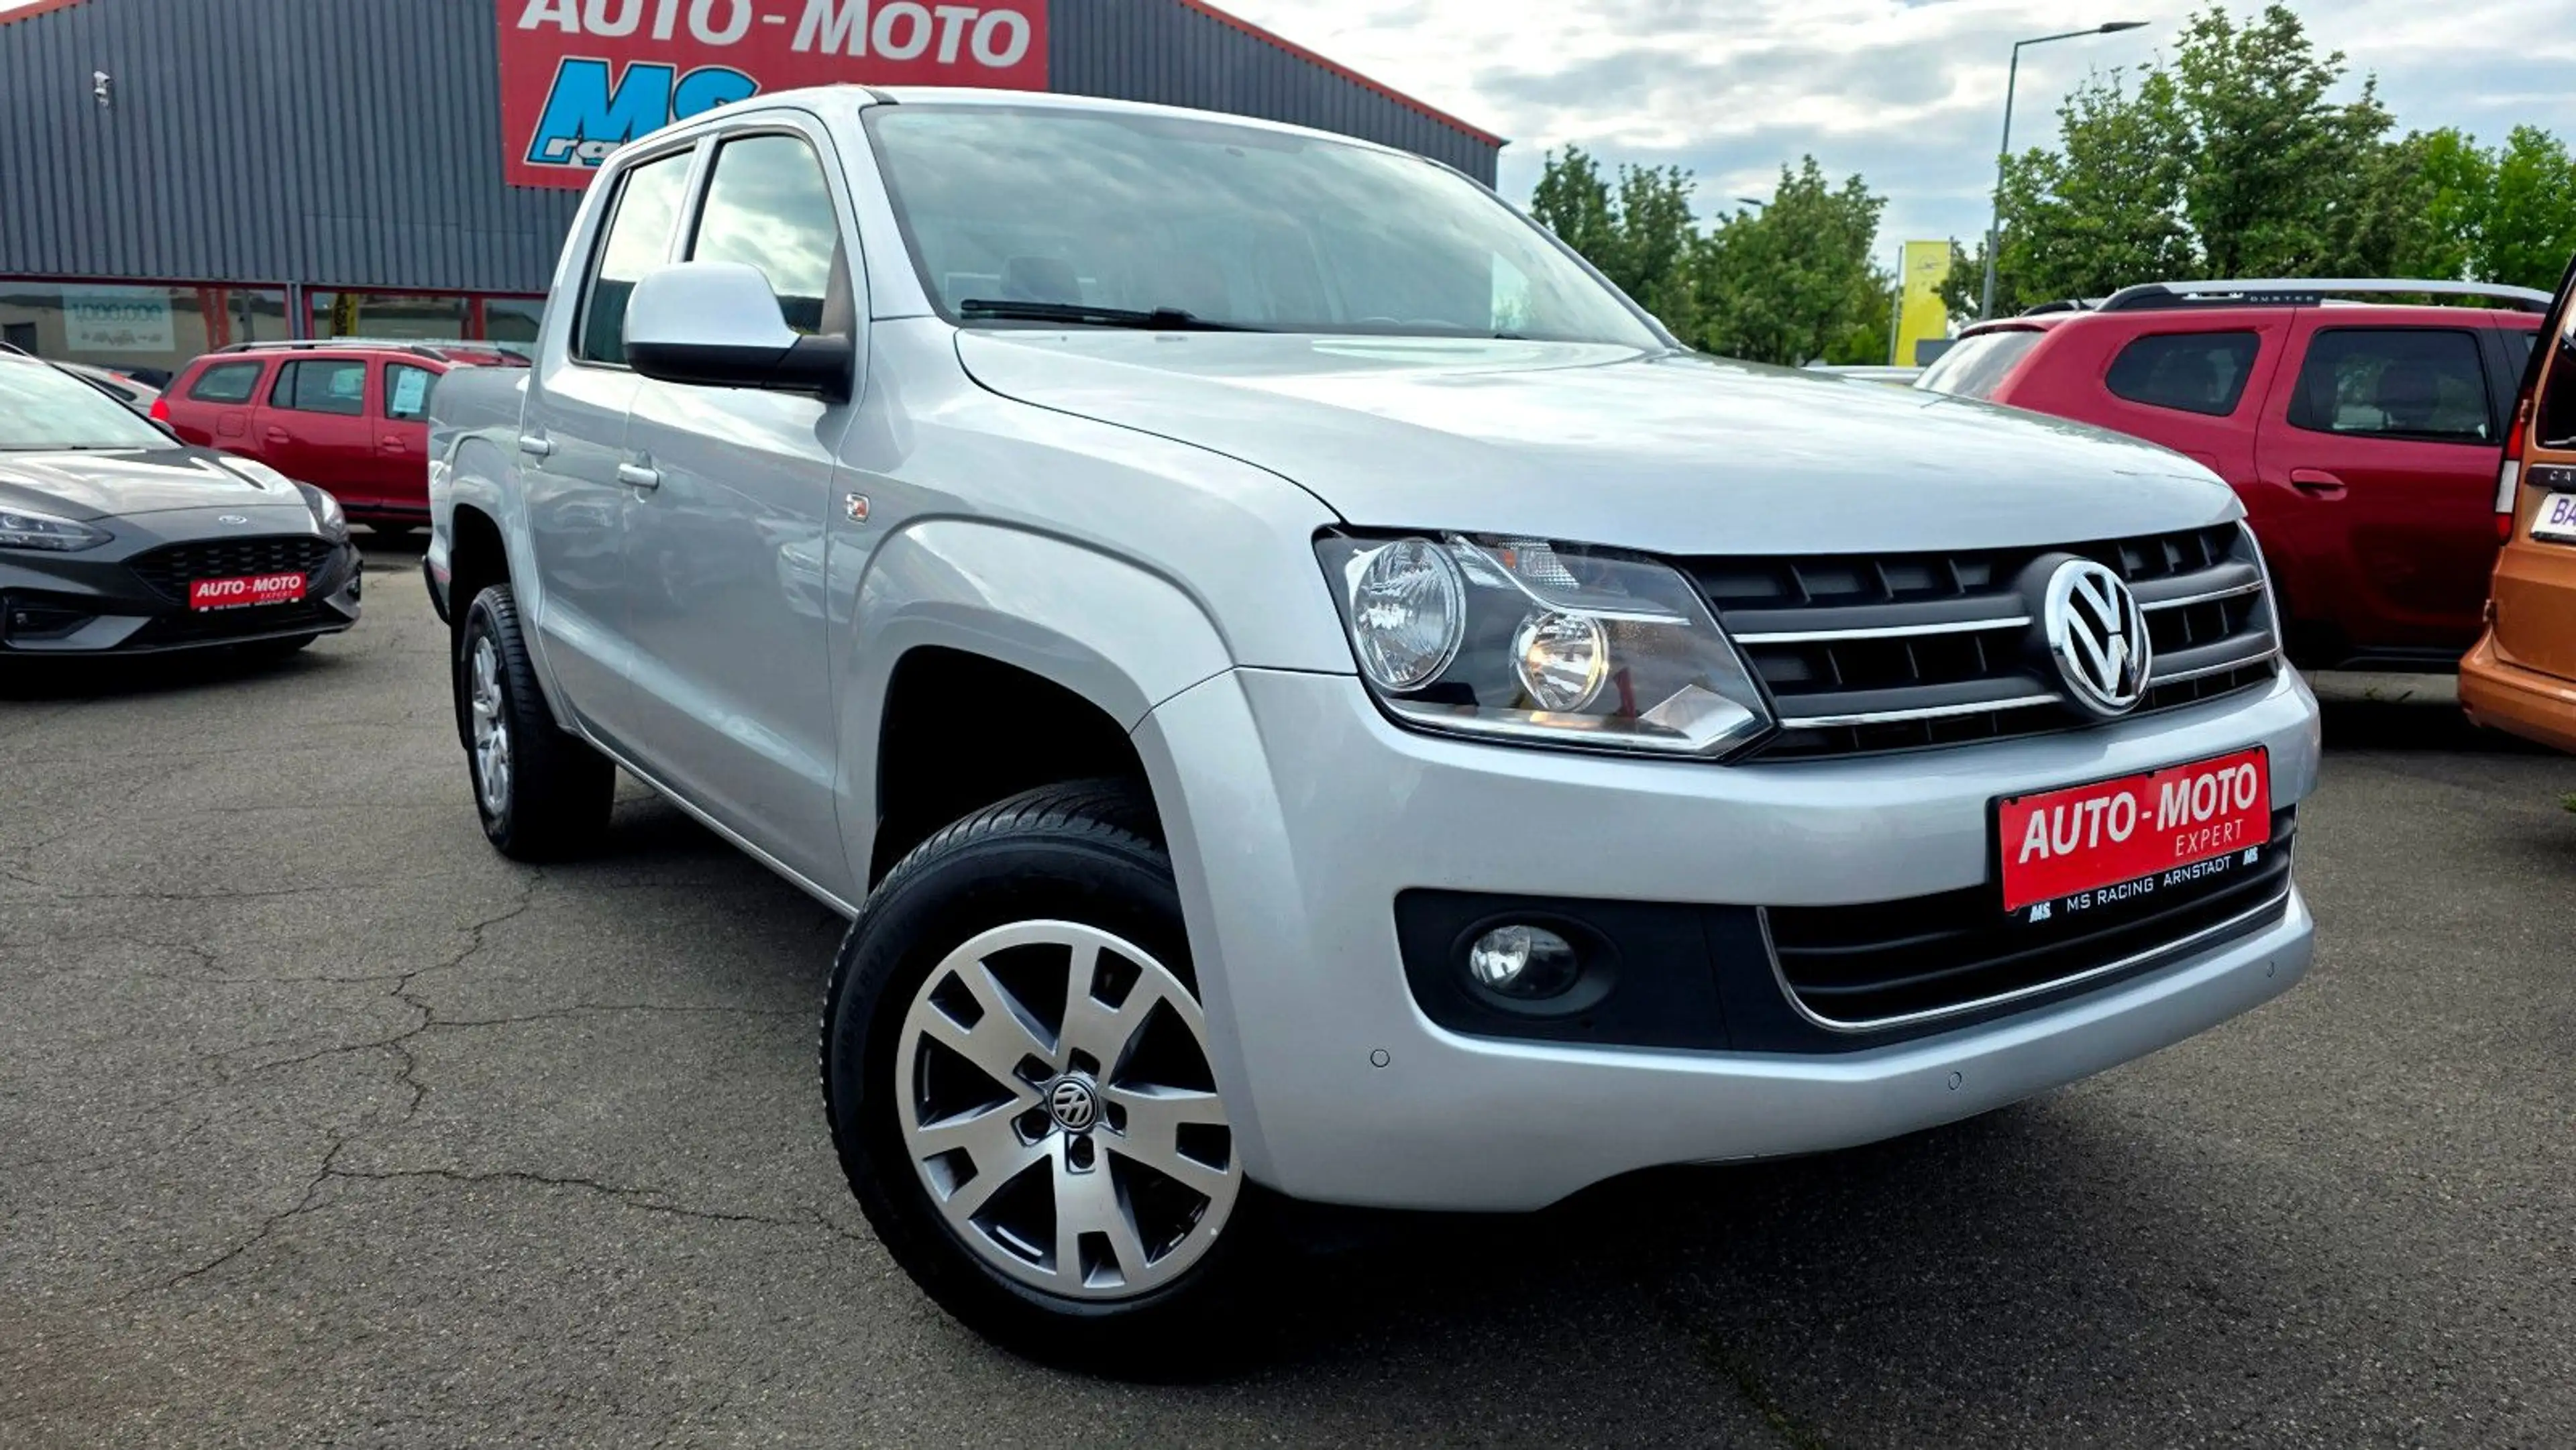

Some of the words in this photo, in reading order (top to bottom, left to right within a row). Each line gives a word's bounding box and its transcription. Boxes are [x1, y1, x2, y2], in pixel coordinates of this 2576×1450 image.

[2019, 763, 2257, 864] AUTO-MOTO
[2175, 819, 2244, 858] EXPERT
[2067, 893, 2091, 913] MS
[2097, 877, 2154, 905] RACING
[2163, 856, 2232, 887] ARNSTADT
